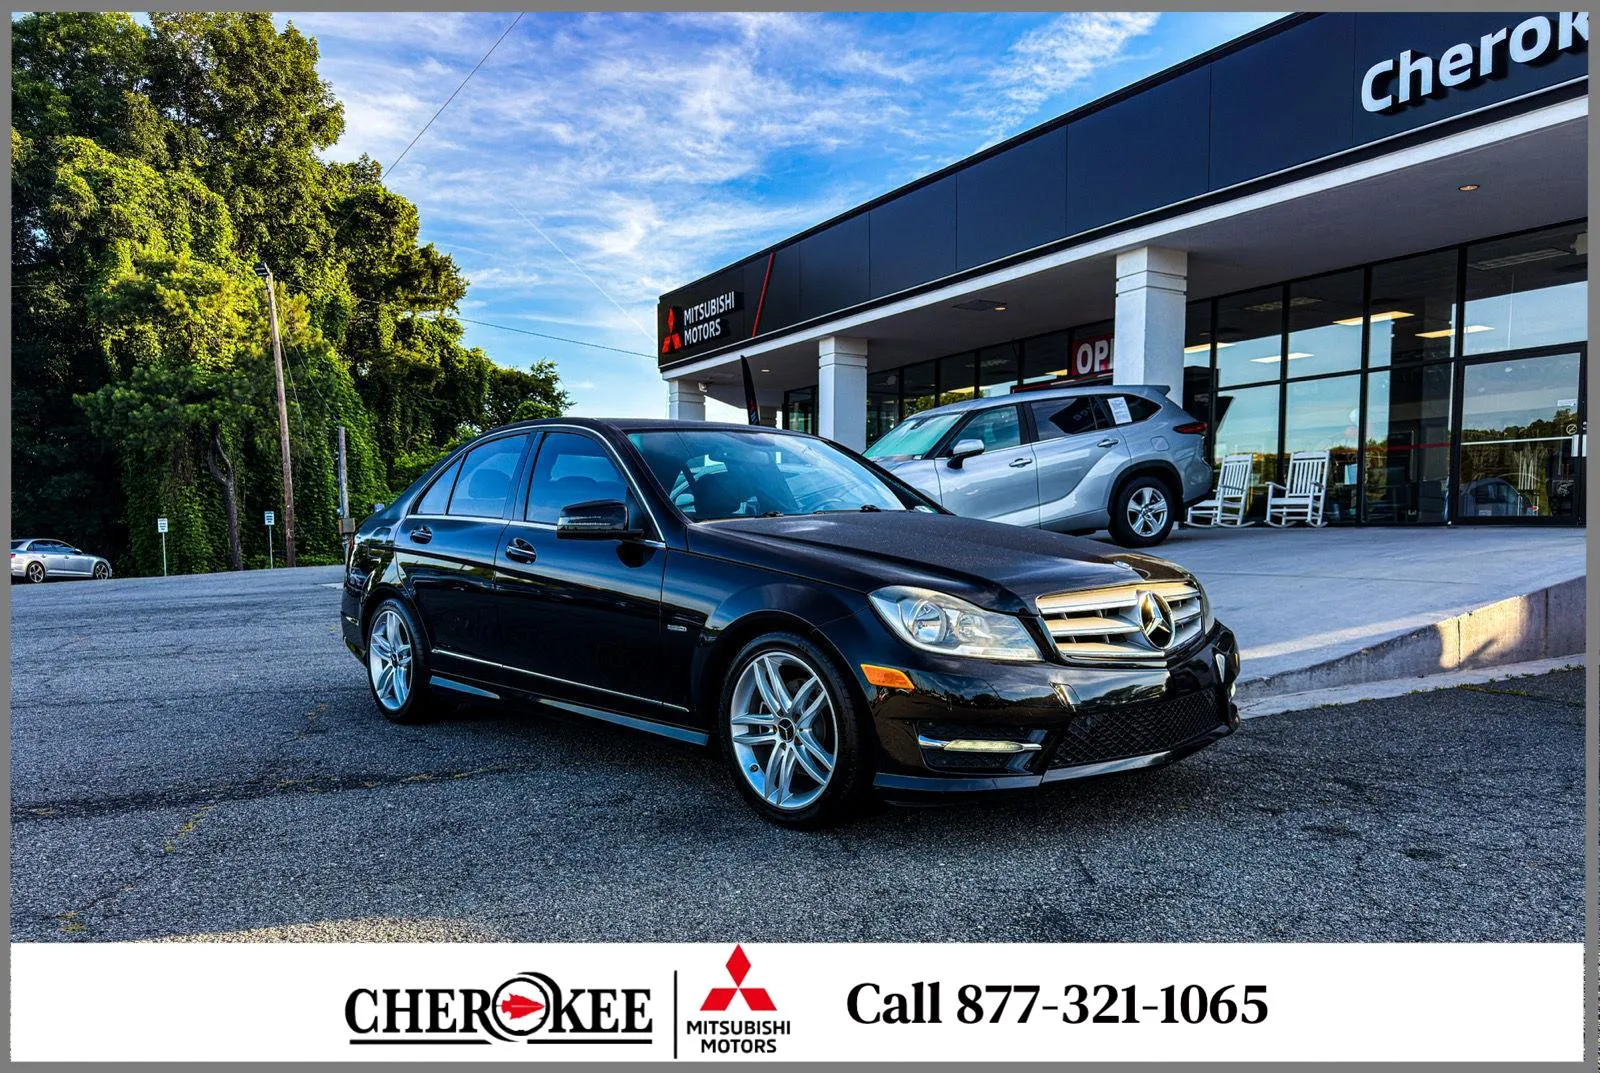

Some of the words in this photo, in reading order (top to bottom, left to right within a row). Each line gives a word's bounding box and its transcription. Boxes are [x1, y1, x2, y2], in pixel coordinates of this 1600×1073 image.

[683, 291, 735, 326] MITSUBISHI
[684, 318, 721, 346] MOTORS
[1076, 338, 1114, 375] OP
